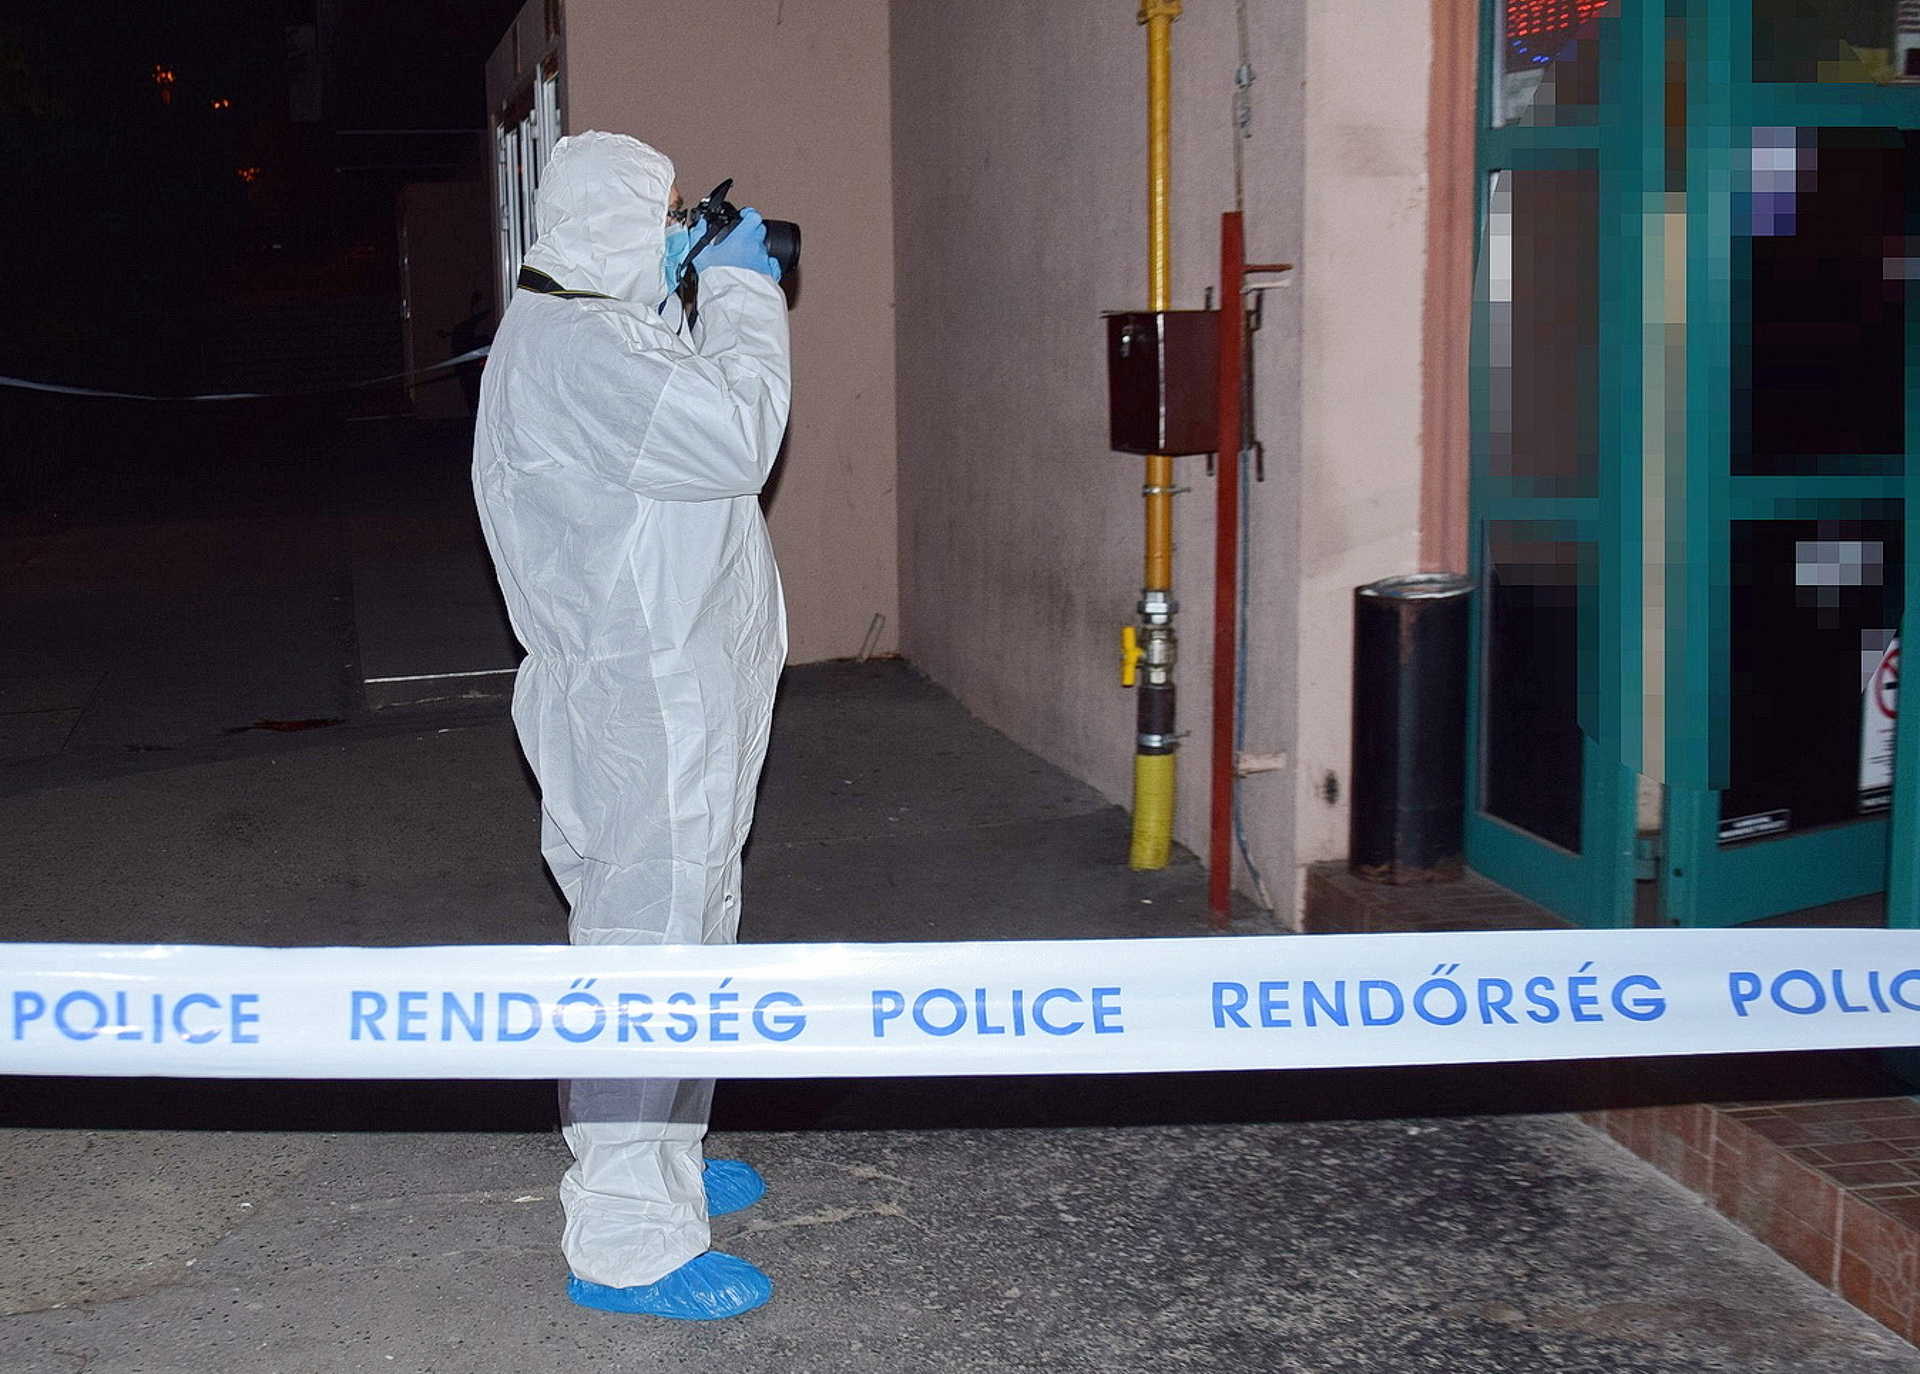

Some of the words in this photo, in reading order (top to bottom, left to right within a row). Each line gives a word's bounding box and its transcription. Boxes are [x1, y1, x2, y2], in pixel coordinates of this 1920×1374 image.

[10, 989, 262, 1045] POLICE
[350, 977, 807, 1044] RENDŐRSÉG
[871, 986, 1125, 1038] POLICE
[1211, 960, 1670, 1028] RENDŐRSÉG
